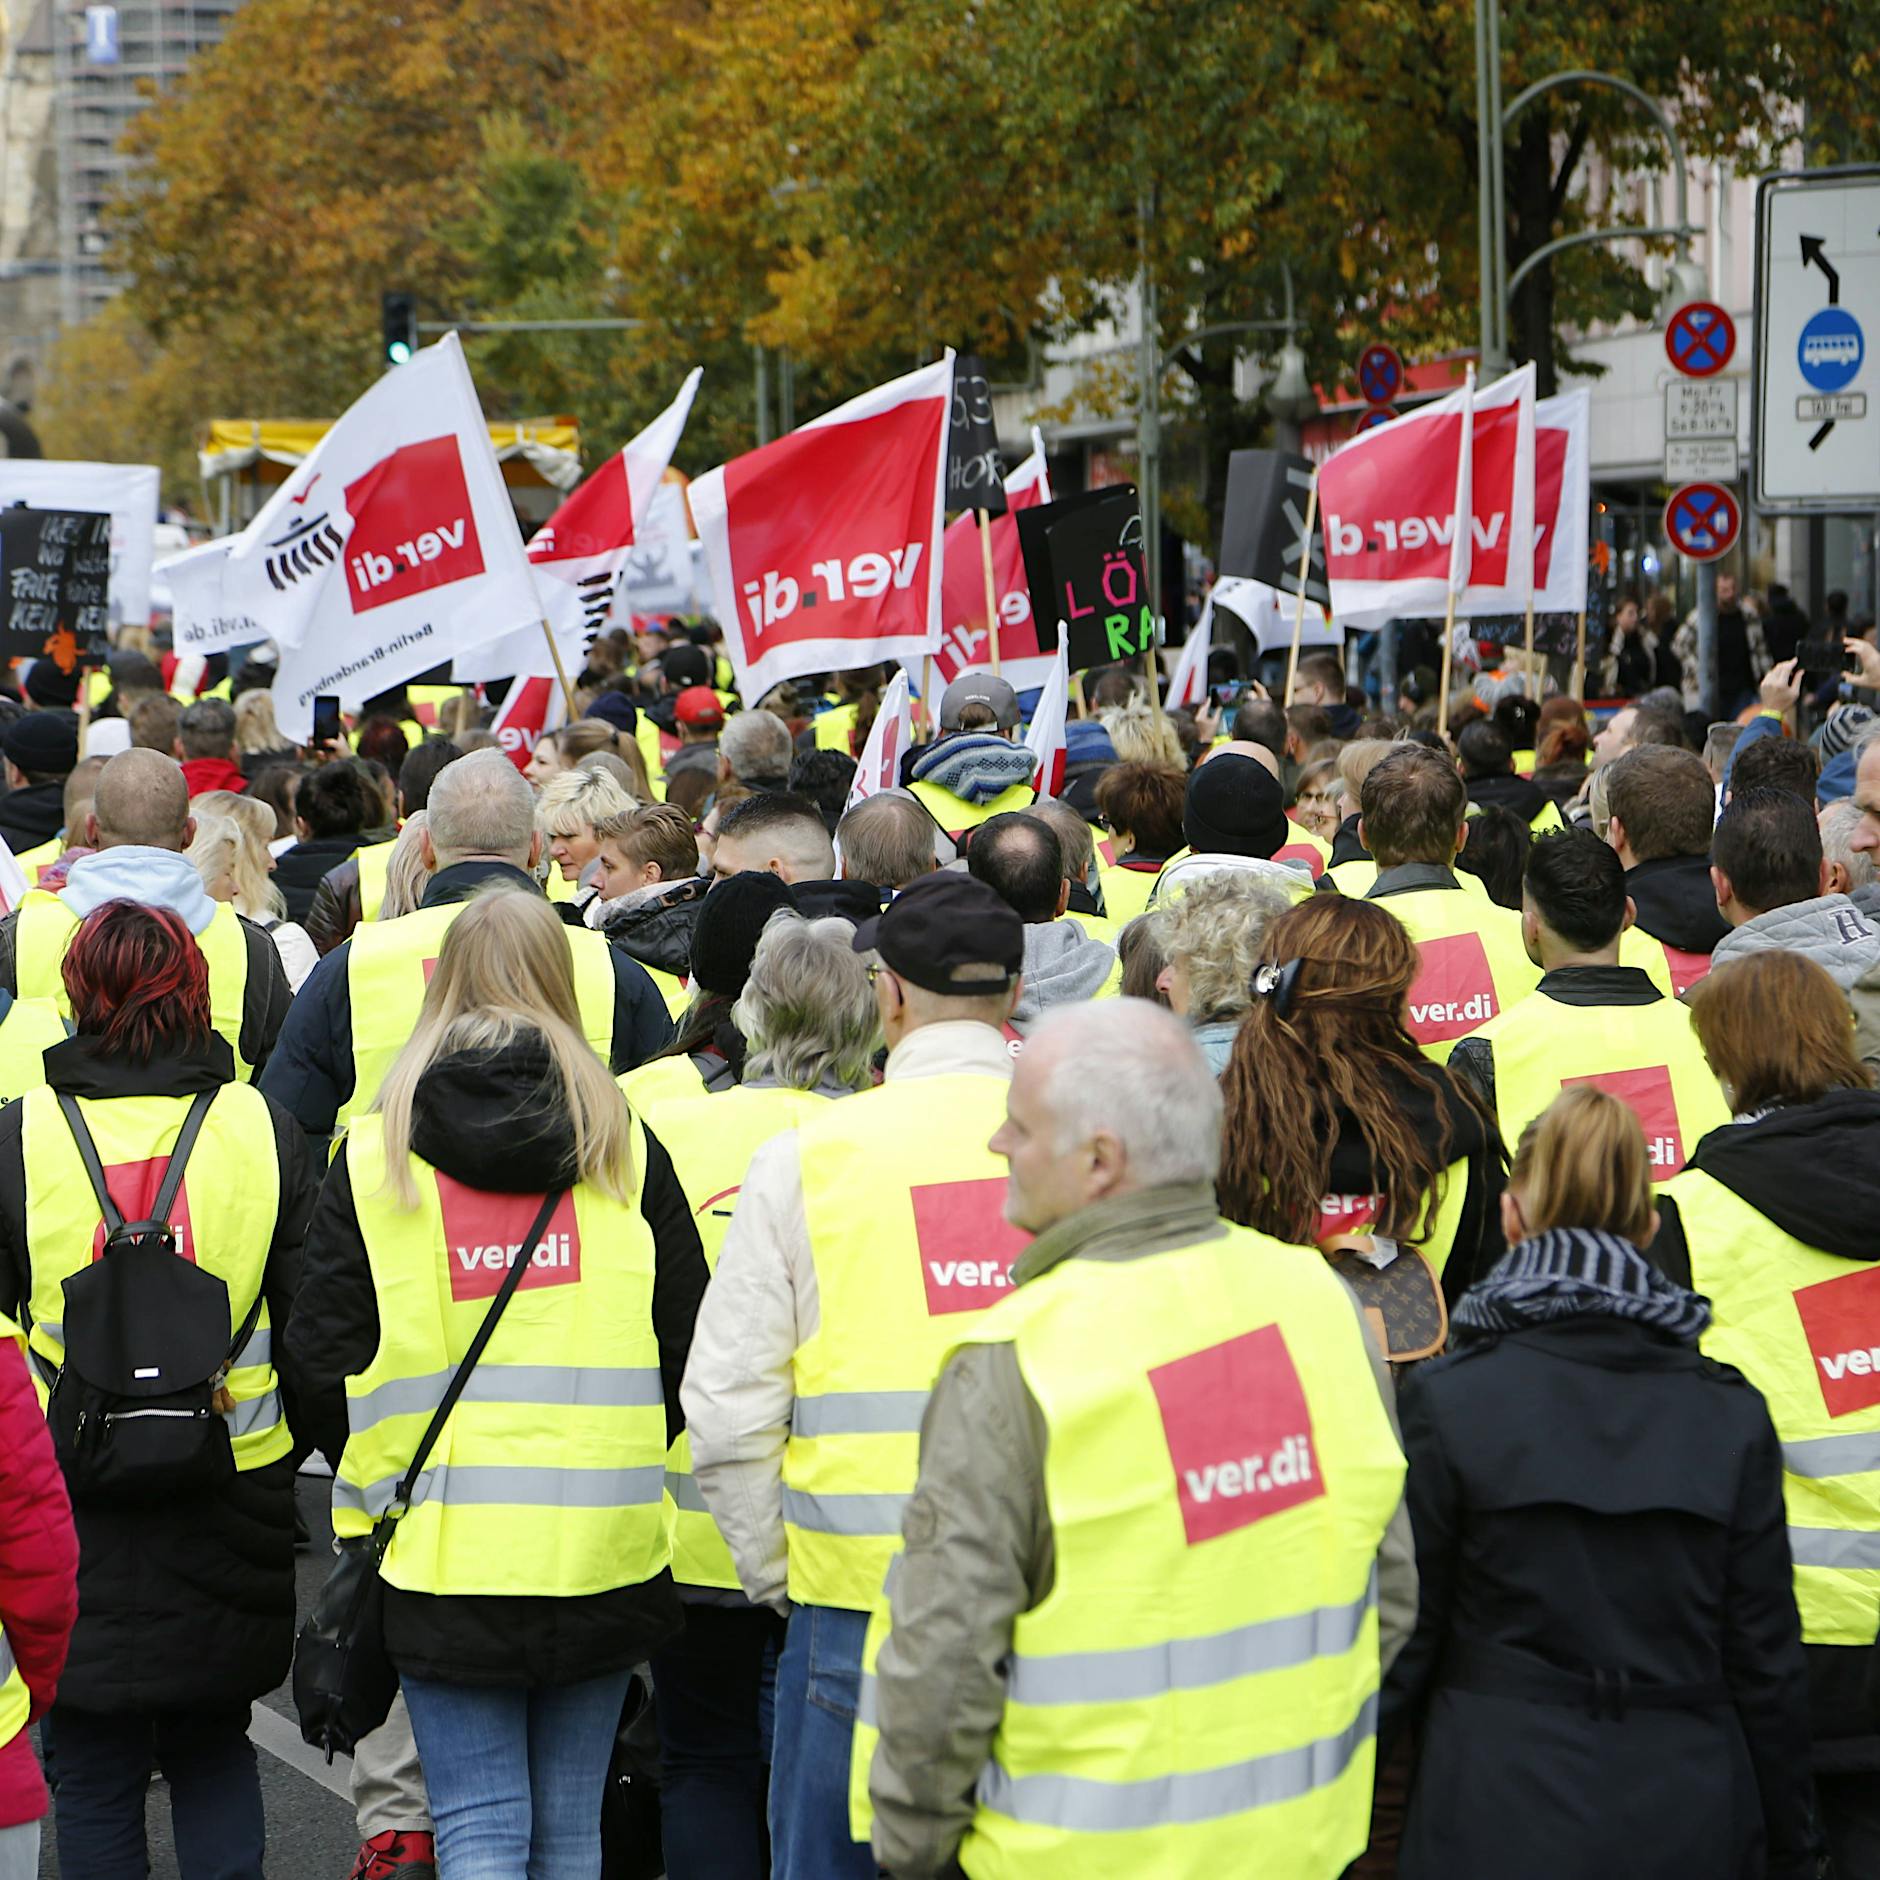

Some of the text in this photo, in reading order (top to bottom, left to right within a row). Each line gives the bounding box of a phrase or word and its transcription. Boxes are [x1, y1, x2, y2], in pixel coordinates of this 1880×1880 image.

[1065, 550, 1148, 619] LÖ
[1409, 993, 1492, 1024] ver.di
[456, 1233, 570, 1271] verdi
[928, 1259, 1018, 1287] ver.
[1184, 1433, 1312, 1503] ver.di
